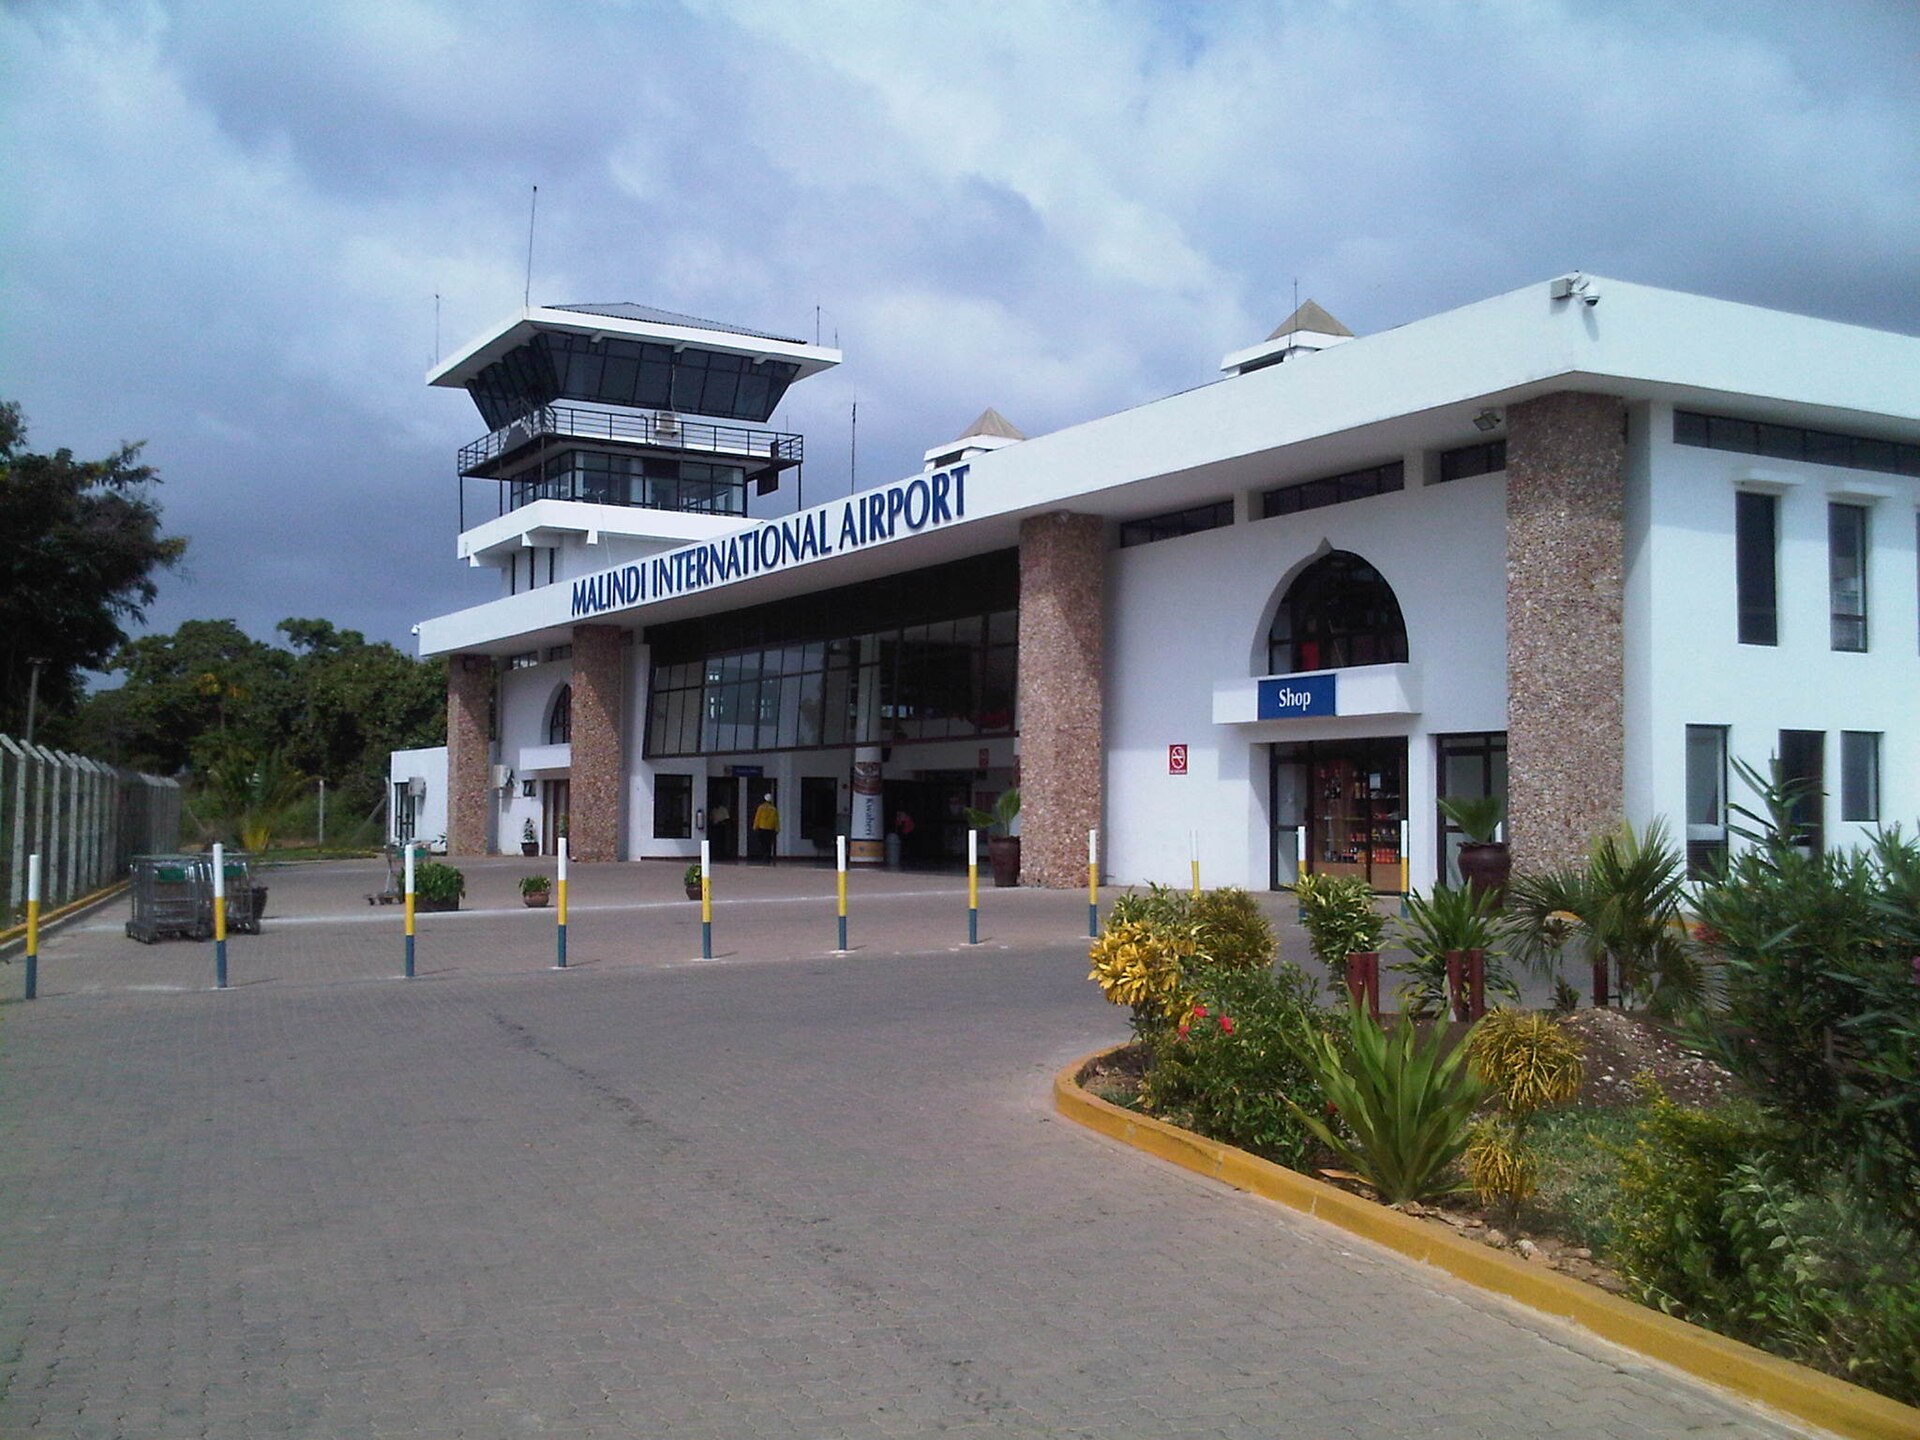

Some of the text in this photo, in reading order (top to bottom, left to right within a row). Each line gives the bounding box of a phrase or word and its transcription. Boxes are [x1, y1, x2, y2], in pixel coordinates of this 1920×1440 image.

[571, 464, 970, 617] MALINDI INTERNATIONAL AIRPORT
[1279, 687, 1311, 711] Shop
